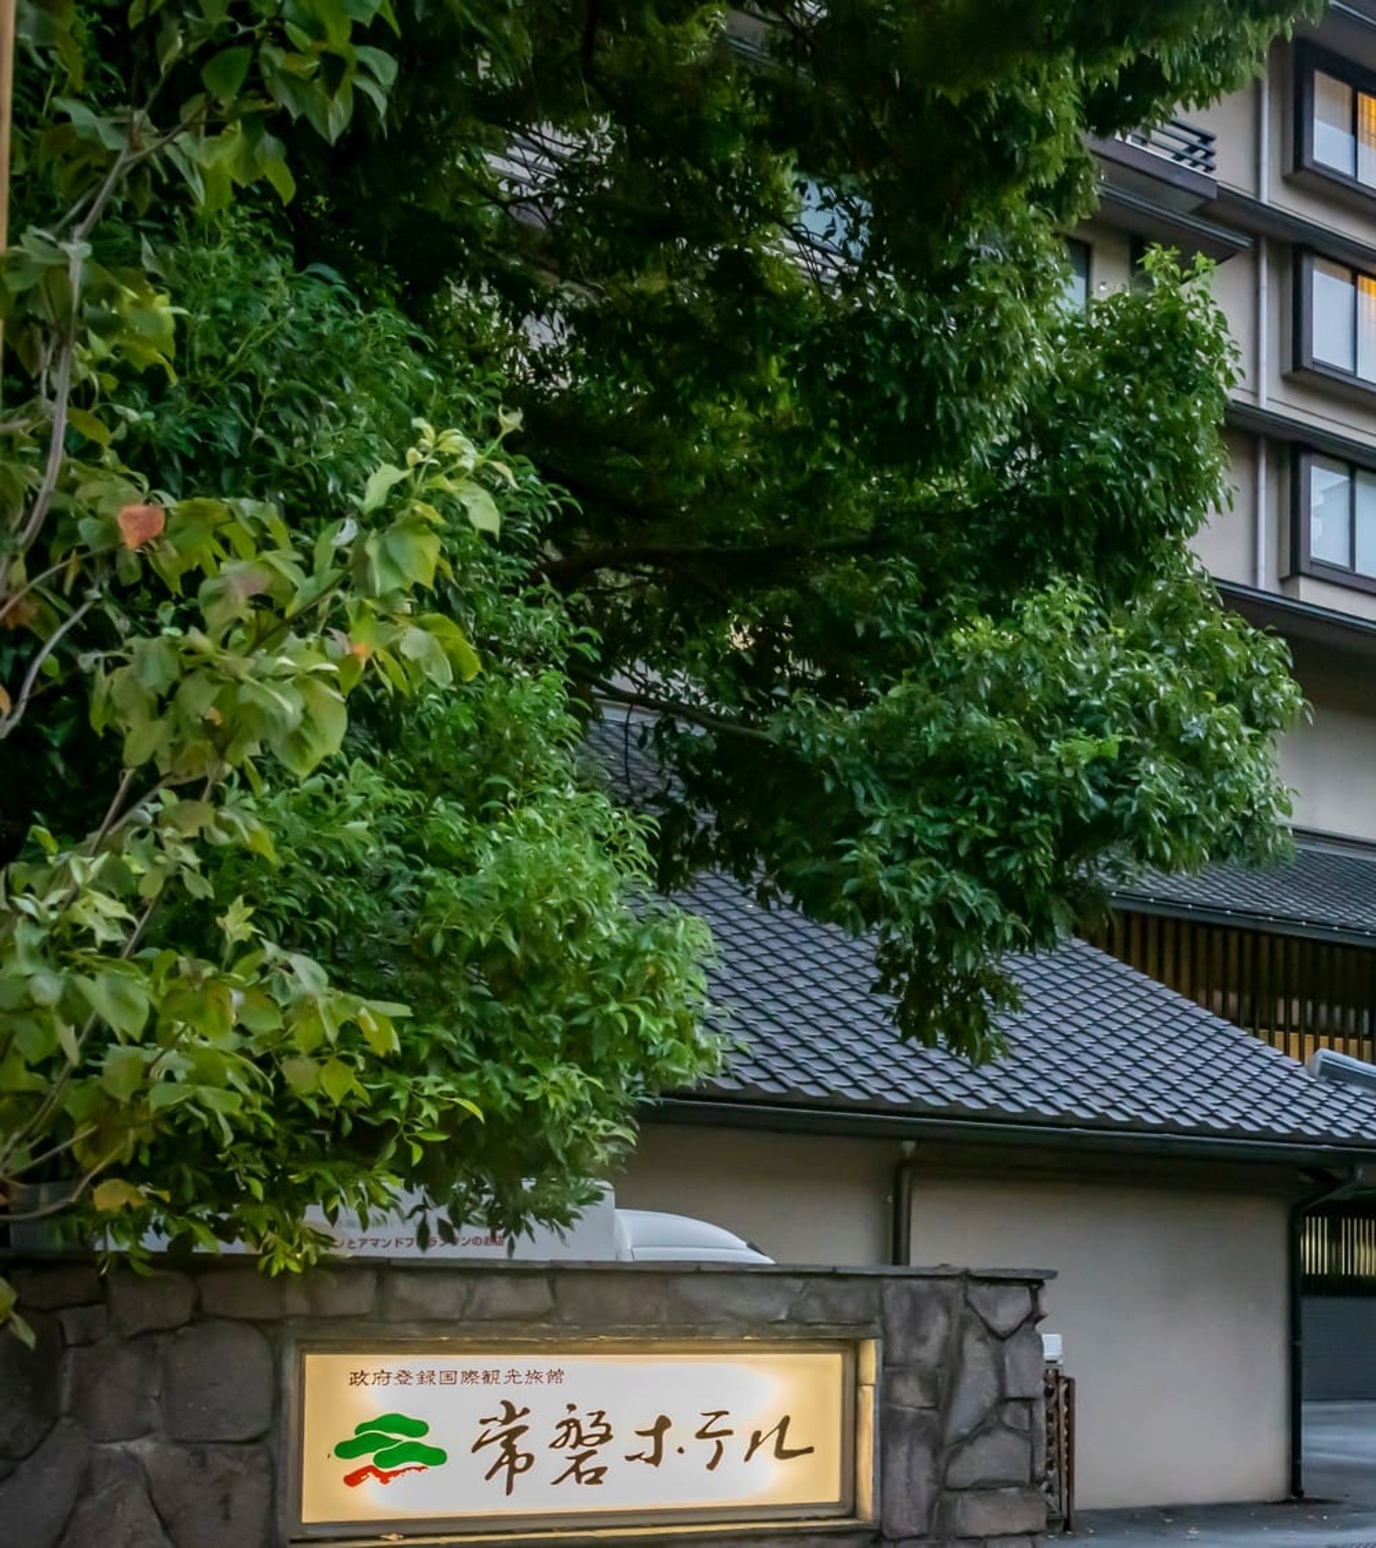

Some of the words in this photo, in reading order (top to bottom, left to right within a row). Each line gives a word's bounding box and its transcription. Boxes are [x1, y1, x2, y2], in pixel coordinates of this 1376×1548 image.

[348, 1368, 565, 1387] 政府登録国際観光旅館
